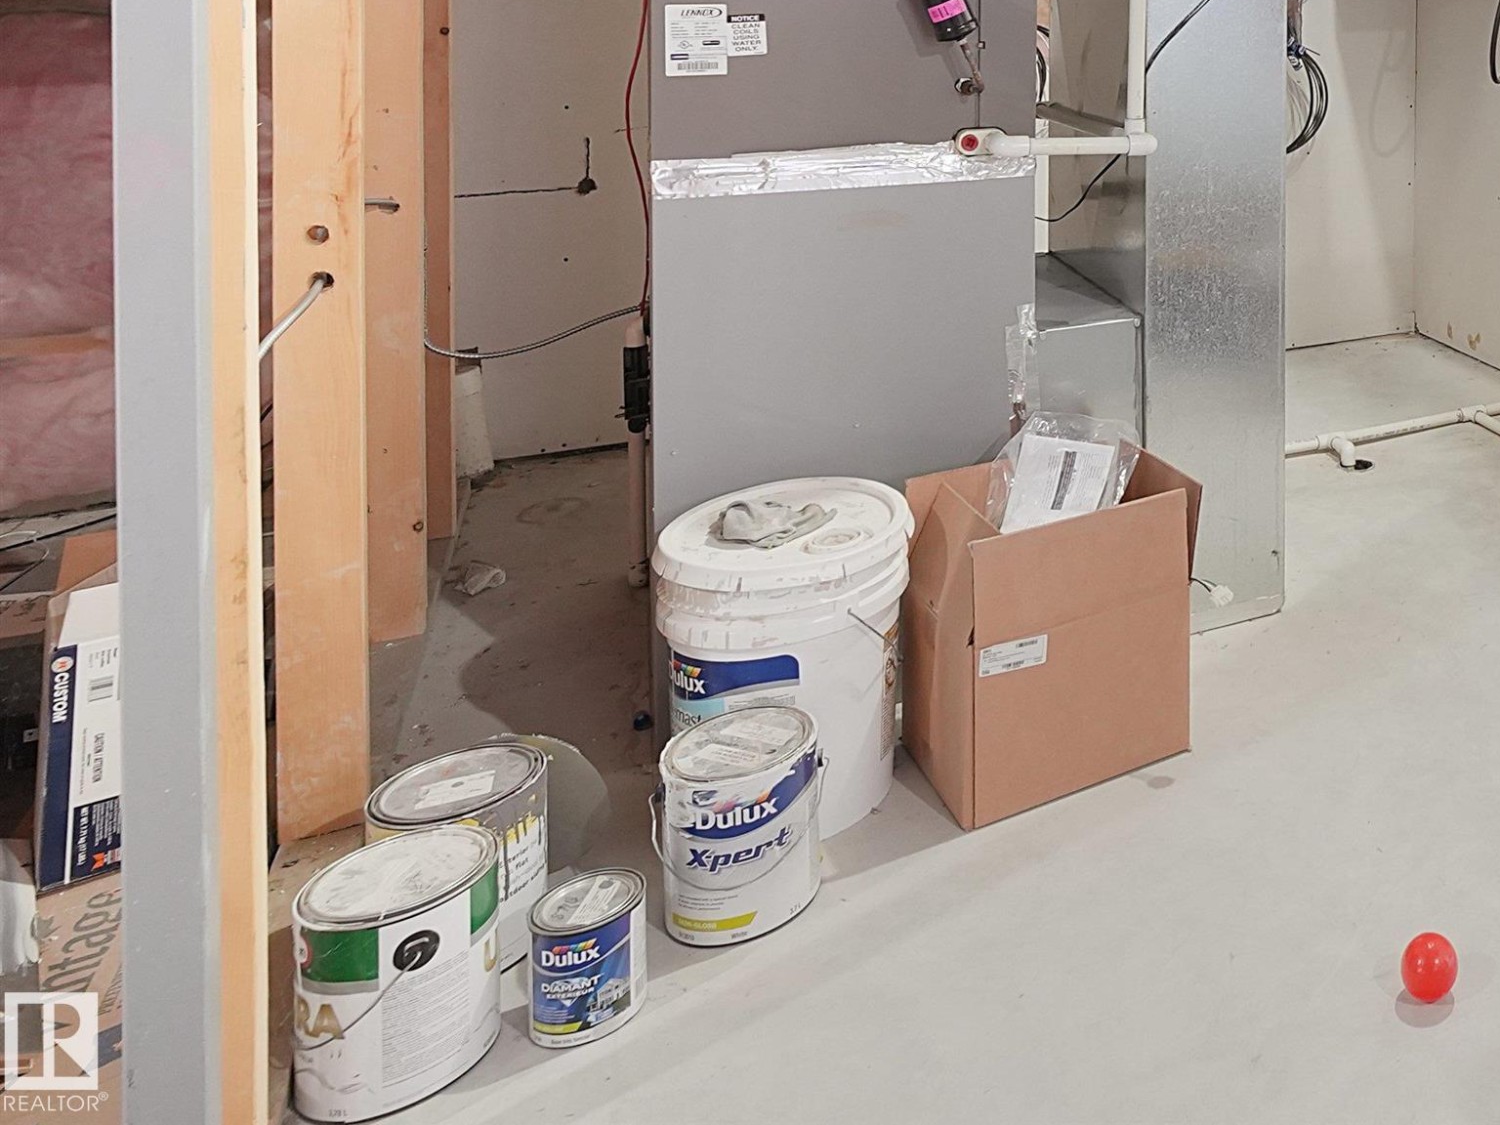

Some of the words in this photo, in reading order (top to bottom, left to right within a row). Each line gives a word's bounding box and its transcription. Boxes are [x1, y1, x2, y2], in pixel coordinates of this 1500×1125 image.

[680, 9, 714, 17] LENNOX
[52, 672, 70, 724] CUSTOM
[695, 797, 779, 830] Dulux
[541, 945, 601, 967] Dulux
[541, 974, 601, 994] DIAMANT
